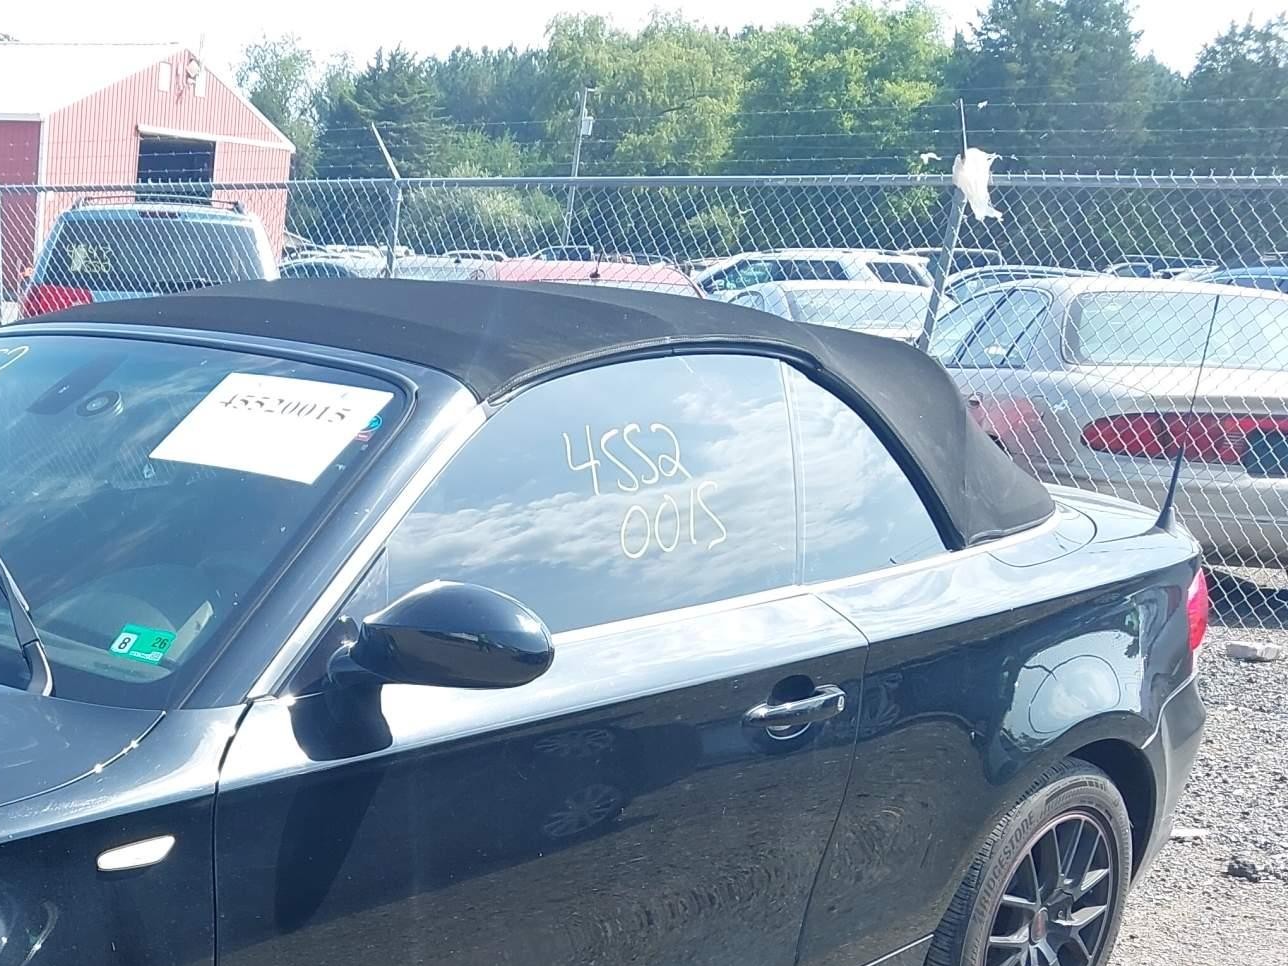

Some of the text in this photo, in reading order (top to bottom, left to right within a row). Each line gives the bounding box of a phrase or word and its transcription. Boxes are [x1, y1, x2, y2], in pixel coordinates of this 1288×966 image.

[220, 393, 352, 423] 45520015
[562, 422, 694, 497] 4552
[620, 480, 727, 560] 0015
[117, 636, 169, 650] 8 26
